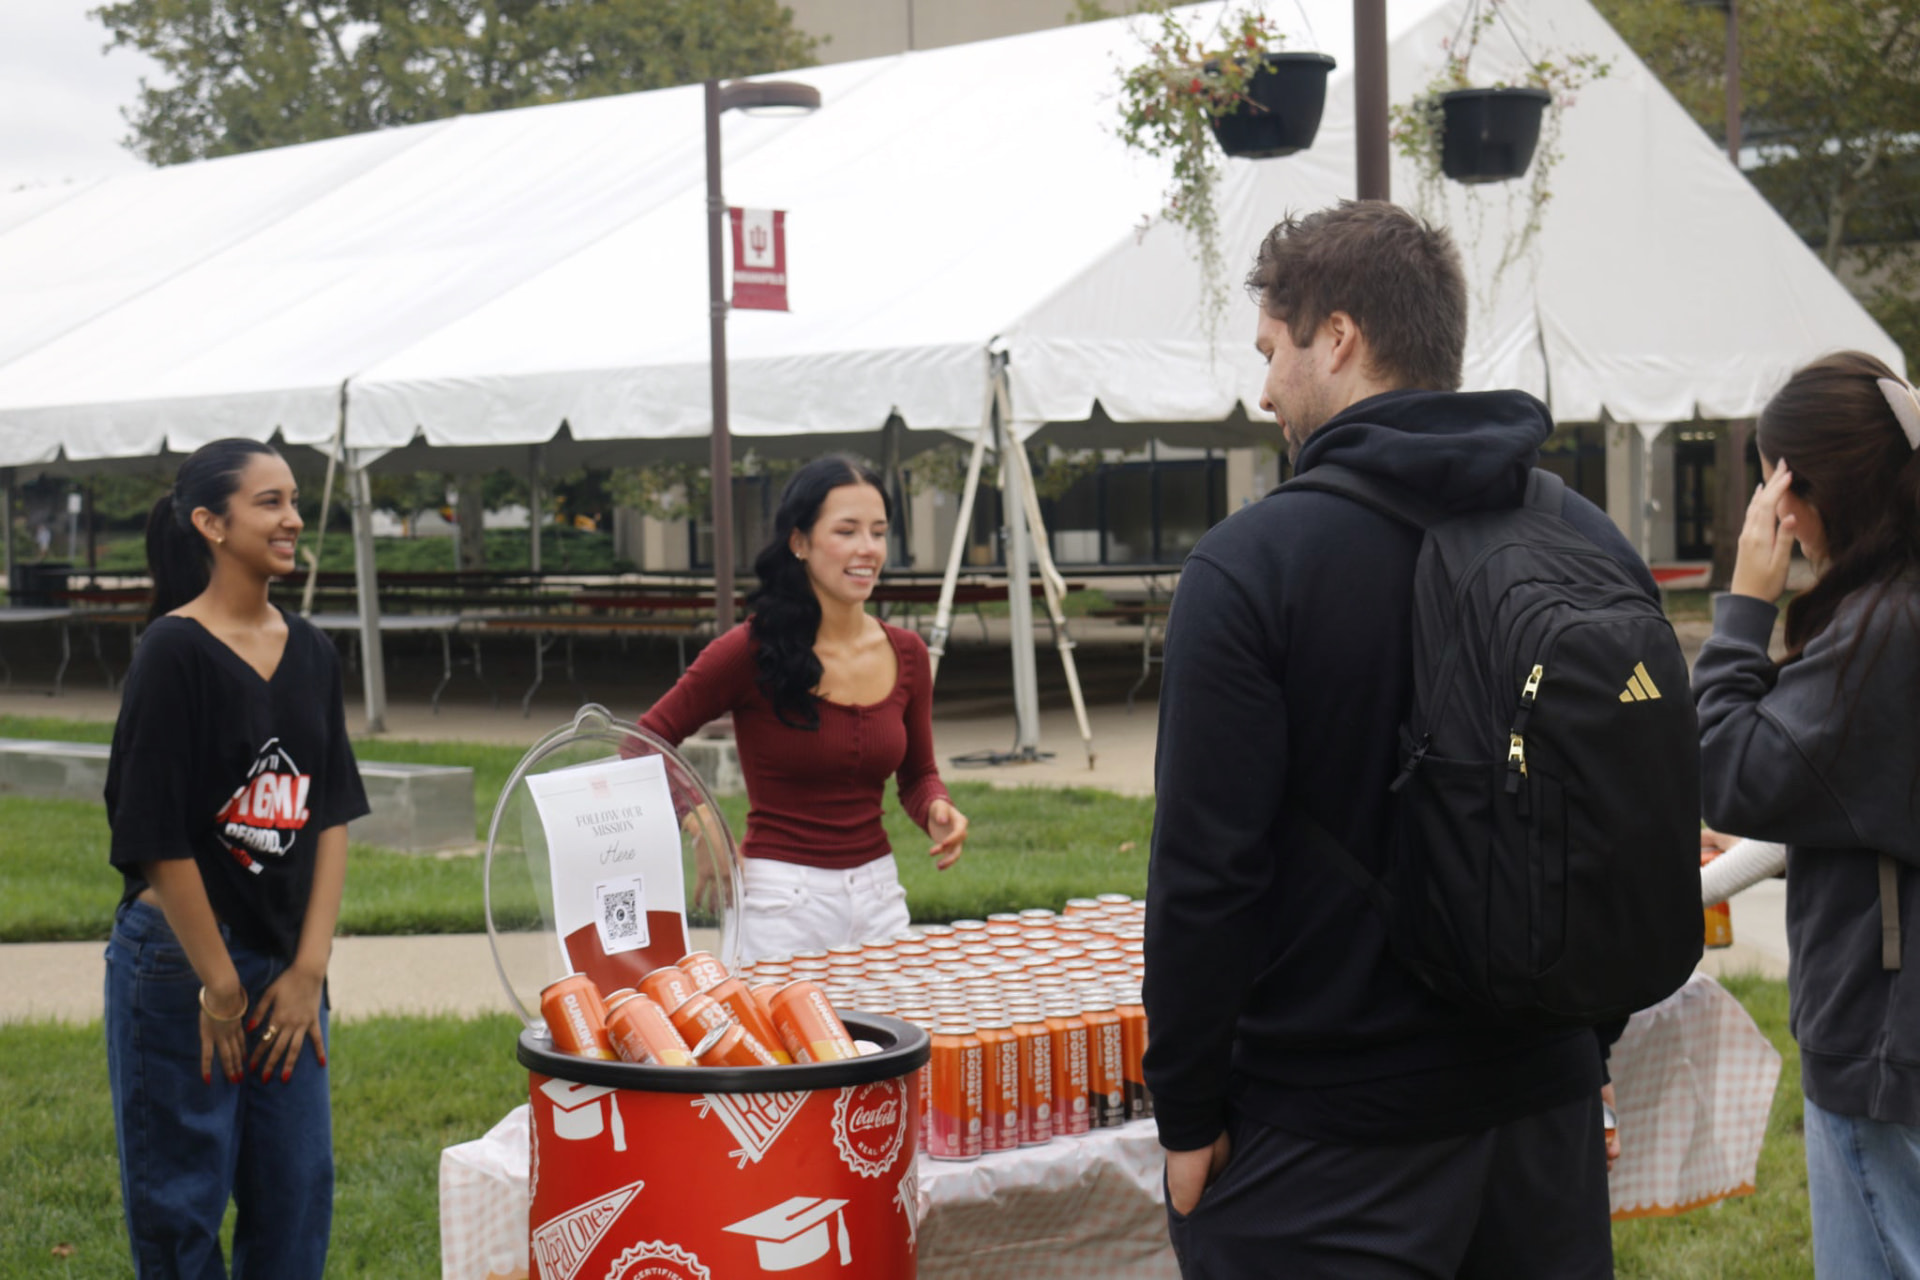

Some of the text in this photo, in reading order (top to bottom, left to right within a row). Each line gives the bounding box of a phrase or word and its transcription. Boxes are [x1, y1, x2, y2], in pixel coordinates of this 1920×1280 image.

[576, 805, 643, 828] FOLLOW OUR
[592, 820, 635, 837] MISSION
[600, 839, 636, 865] Here
[725, 1092, 799, 1143] Rea
[858, 1141, 878, 1156] REAL
[568, 1204, 614, 1253] Ones
